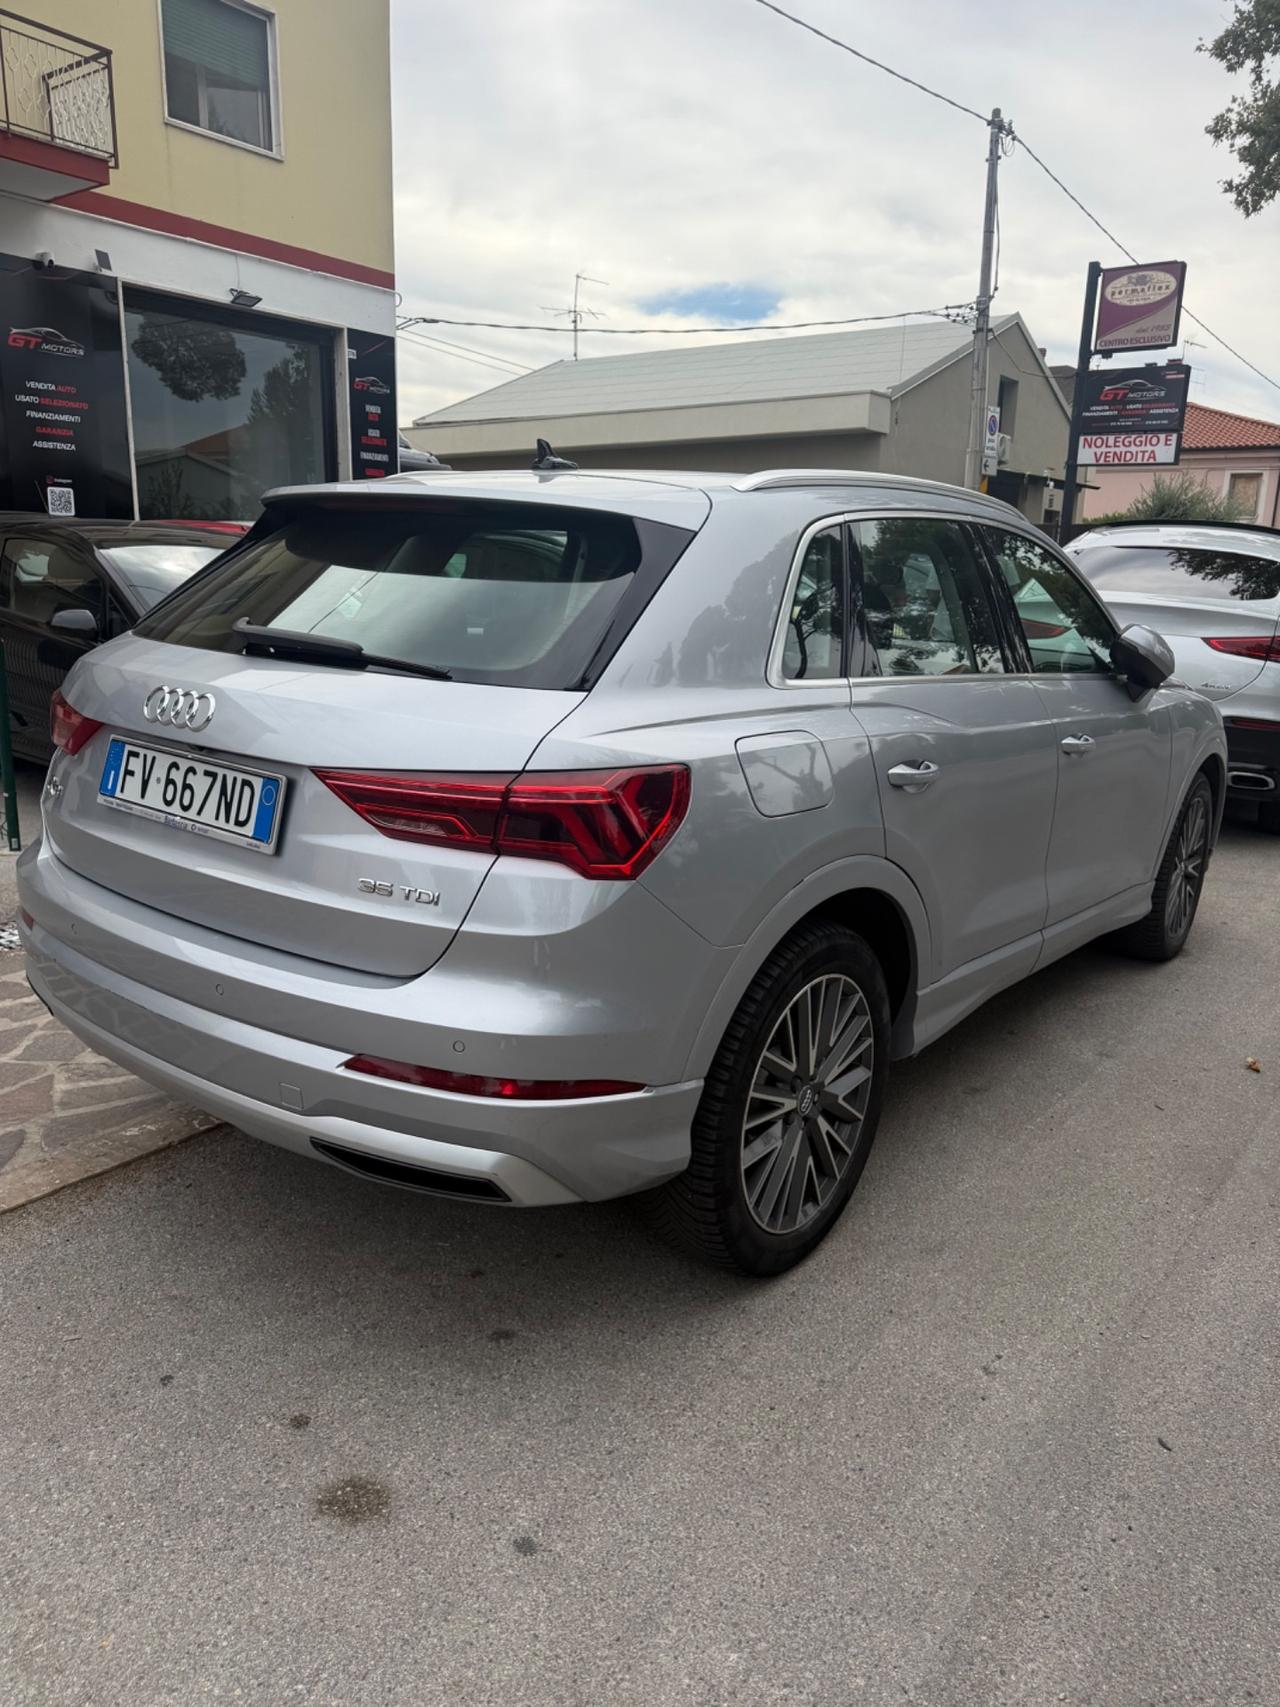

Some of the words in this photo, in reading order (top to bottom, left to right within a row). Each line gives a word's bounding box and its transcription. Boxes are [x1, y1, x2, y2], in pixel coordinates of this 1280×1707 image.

[1110, 284, 1170, 297] permaflex
[8, 334, 42, 349] GT
[41, 343, 85, 356] MOTORS
[1100, 338, 1129, 347] CENTRO
[1129, 335, 1171, 345] ESCLUSIVO
[25, 380, 56, 391] VENDITA
[56, 385, 77, 394] AUTO
[15, 394, 40, 404] USATO
[1099, 389, 1130, 401] GT
[1127, 390, 1166, 398] MOTORS
[25, 410, 81, 423] FINANZIAMENTI
[33, 440, 76, 451] ASSISTENZA
[1082, 434, 1160, 449] NOLEGGIO
[1164, 434, 1173, 447] E
[1094, 450, 1157, 463] VENDITA
[120, 750, 156, 799] FV
[162, 761, 256, 828] 667ND
[358, 877, 394, 897] 35
[400, 885, 441, 906] TDI
